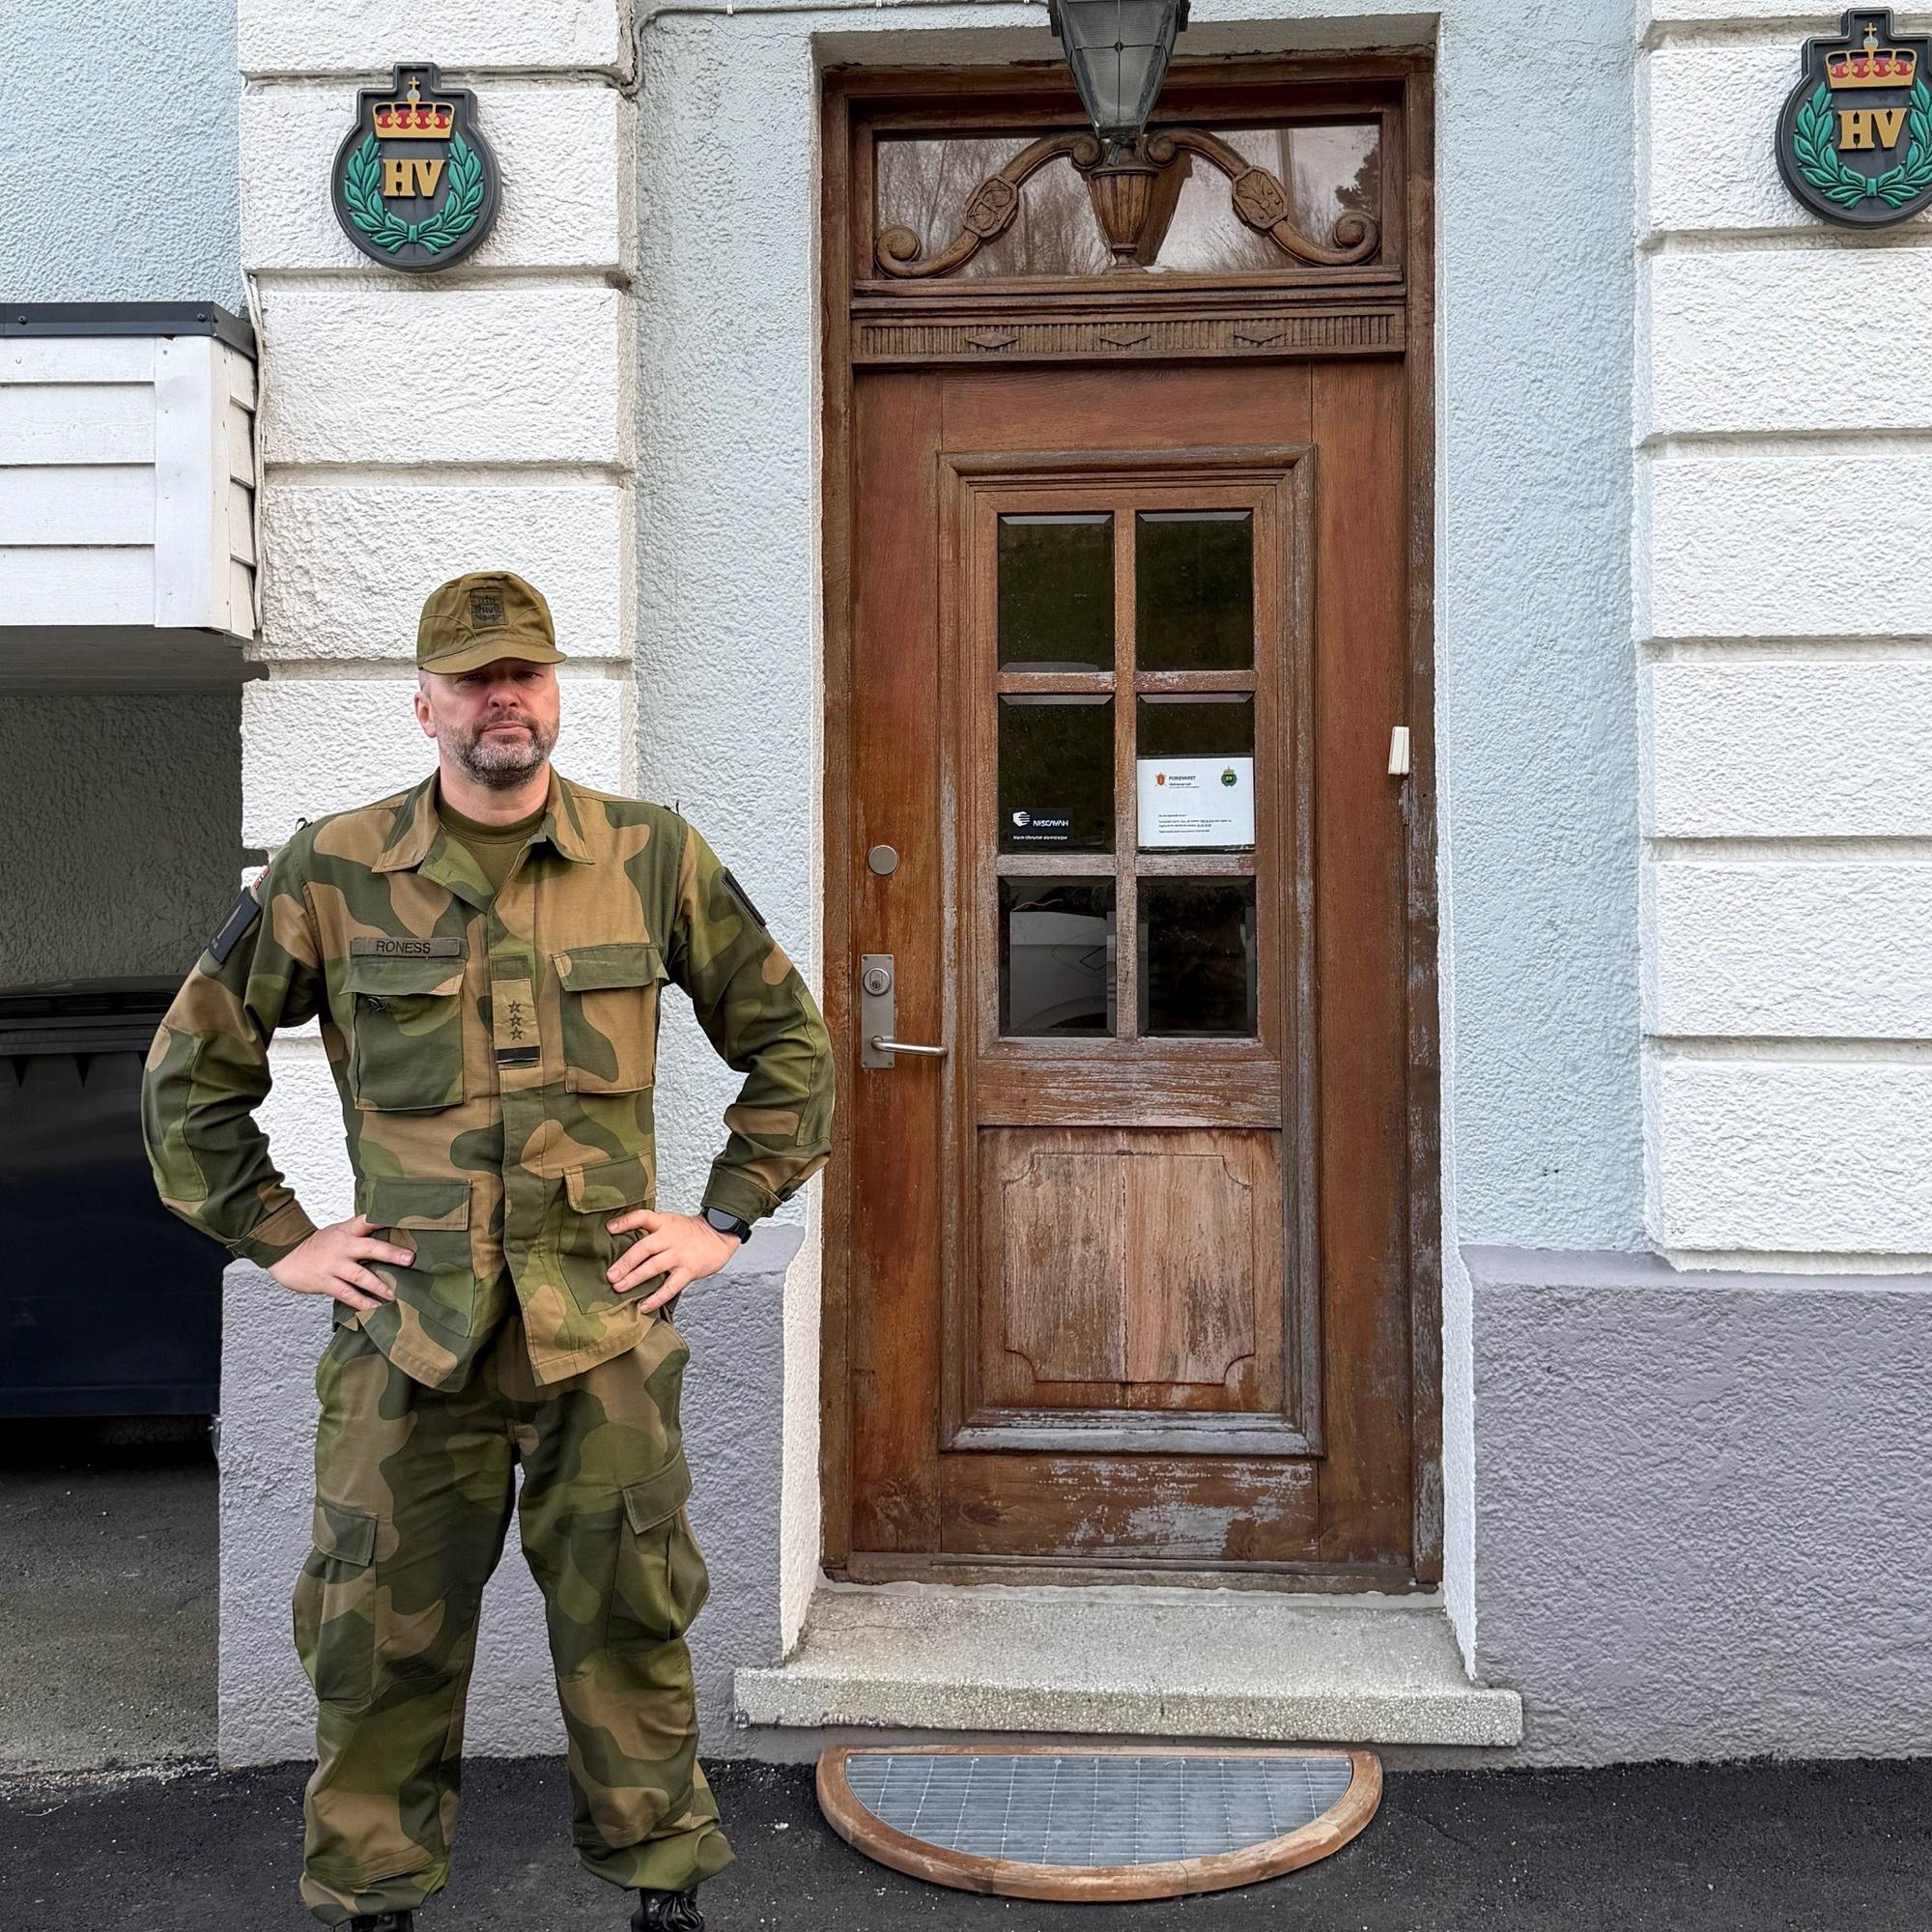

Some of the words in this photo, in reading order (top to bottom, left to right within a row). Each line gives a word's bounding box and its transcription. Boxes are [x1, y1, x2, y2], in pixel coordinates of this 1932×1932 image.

[1838, 108, 1908, 150] HV
[384, 159, 445, 197] HV
[376, 941, 431, 954] RONESS
